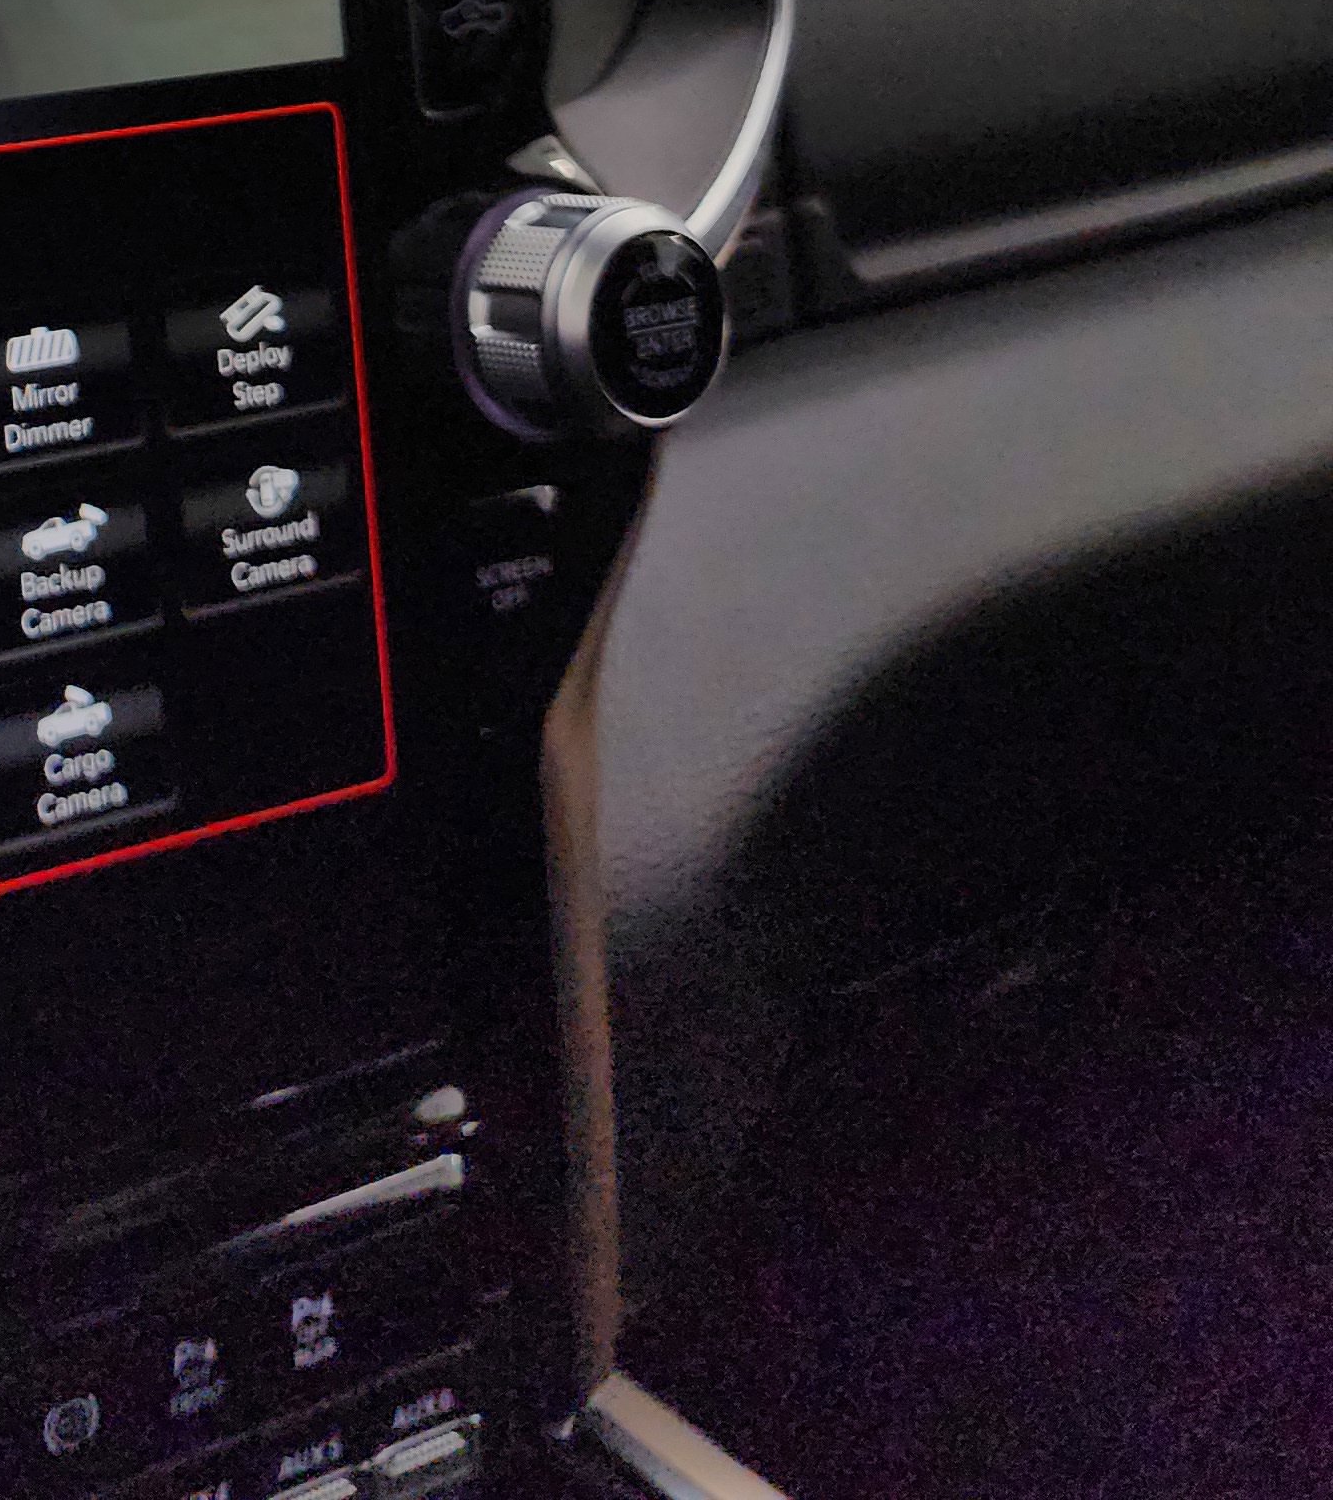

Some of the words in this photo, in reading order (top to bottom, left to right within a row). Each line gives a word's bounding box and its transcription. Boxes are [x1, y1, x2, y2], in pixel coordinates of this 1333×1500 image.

[217, 341, 293, 378] Deploy
[11, 381, 80, 413] Mirror
[233, 381, 285, 411] Step
[4, 416, 94, 453] Dimmer
[222, 510, 320, 558] Surround
[21, 562, 106, 601] Backup
[231, 554, 319, 592] Camera
[21, 601, 113, 639] Camera
[44, 749, 116, 786] Cargo
[37, 782, 129, 826] Camera
